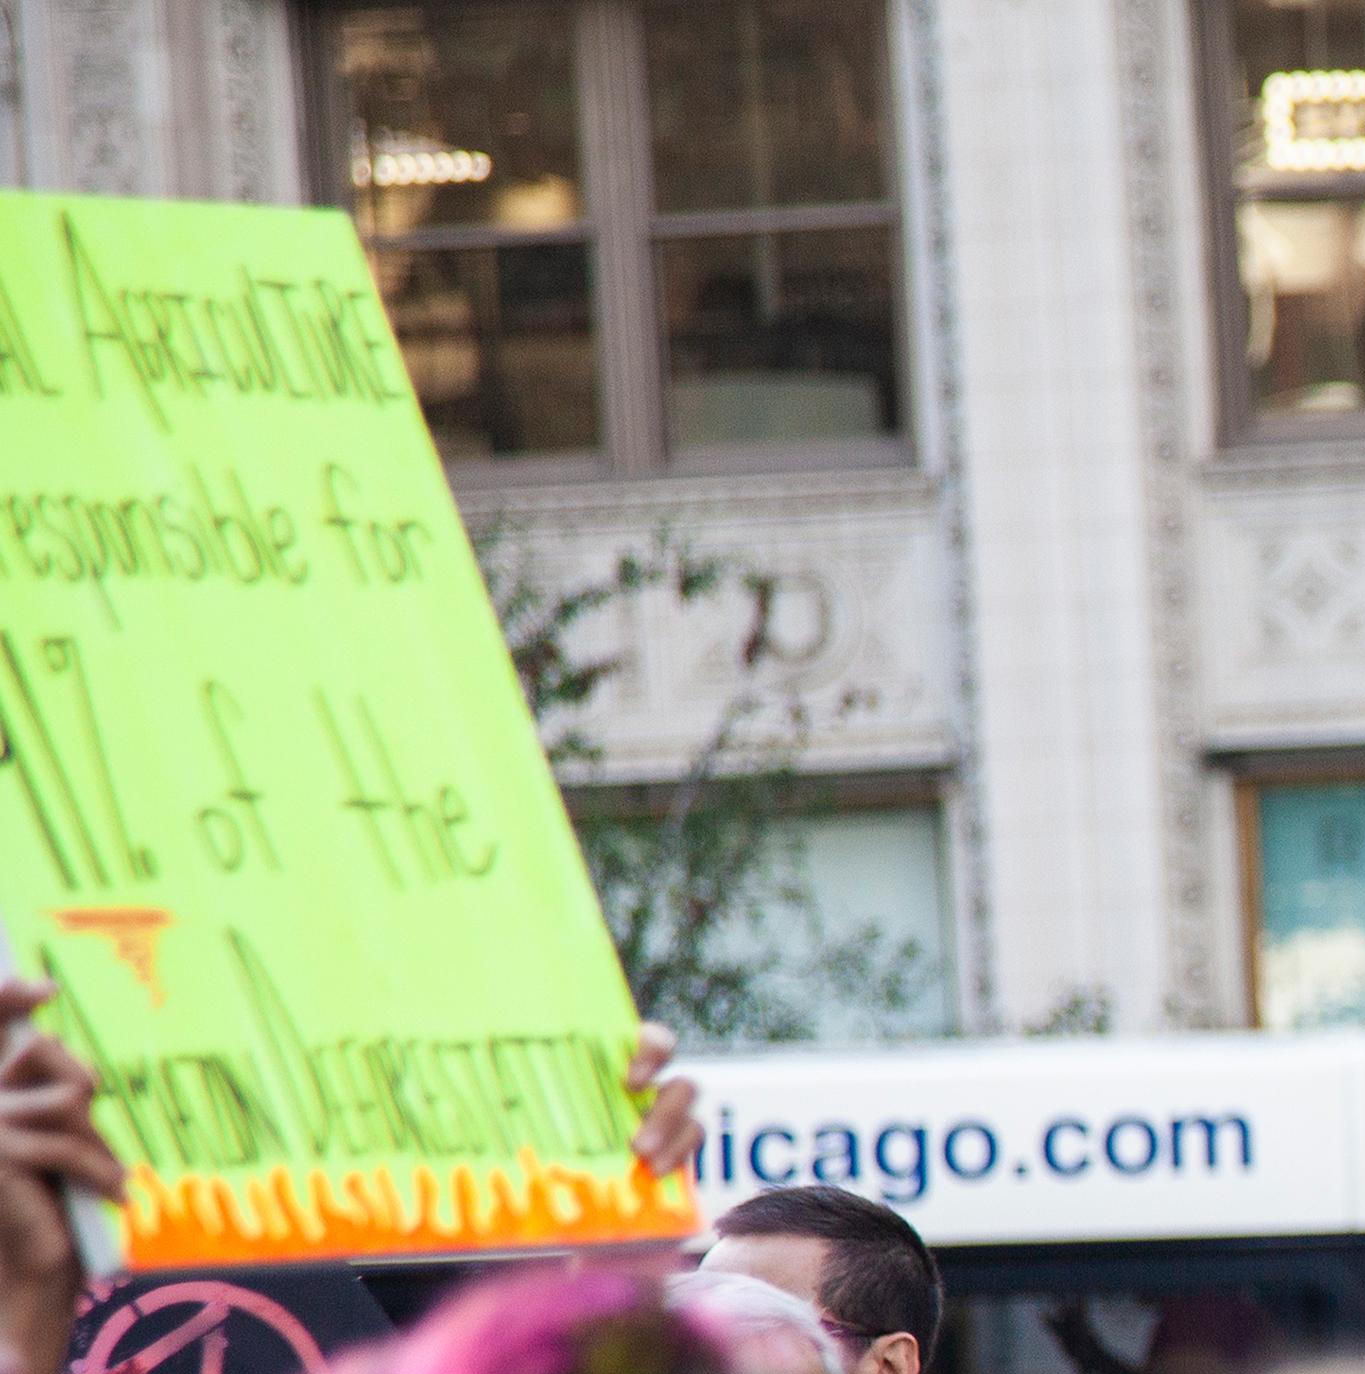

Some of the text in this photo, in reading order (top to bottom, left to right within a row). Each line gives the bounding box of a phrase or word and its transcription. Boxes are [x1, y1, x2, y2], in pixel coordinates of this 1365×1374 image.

[0, 461, 437, 632] esponsible for
[196, 679, 284, 876] of
[314, 686, 498, 894] the
